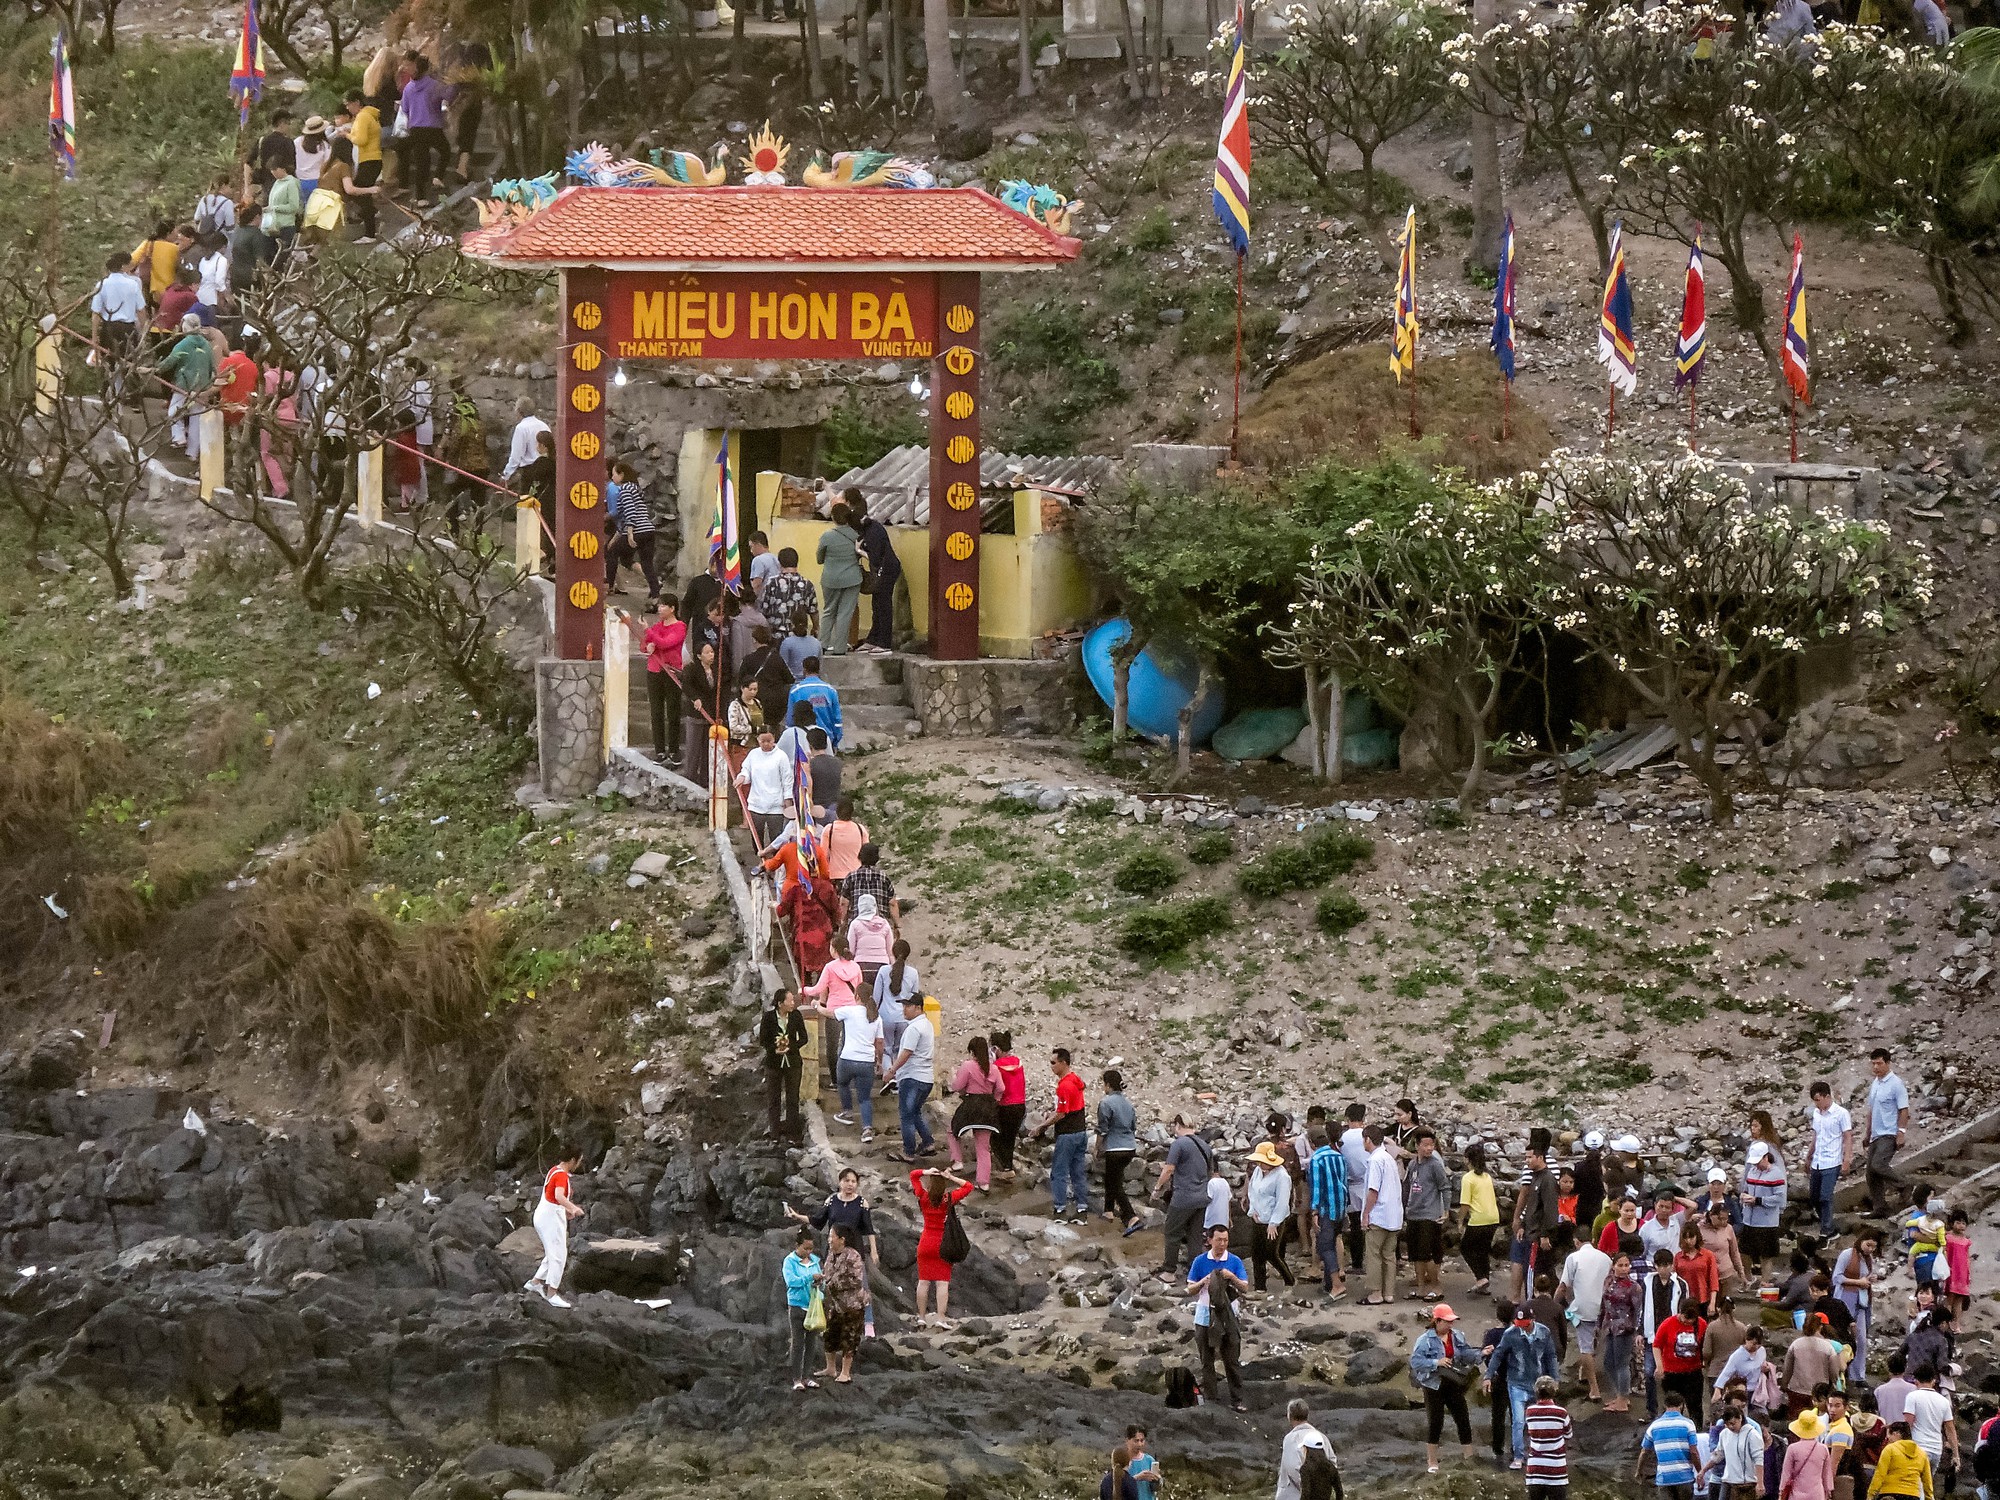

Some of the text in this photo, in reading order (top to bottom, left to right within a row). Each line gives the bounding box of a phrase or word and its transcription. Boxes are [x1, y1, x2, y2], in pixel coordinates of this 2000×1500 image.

[633, 273, 915, 340] MIẾU HÒN BÀ
